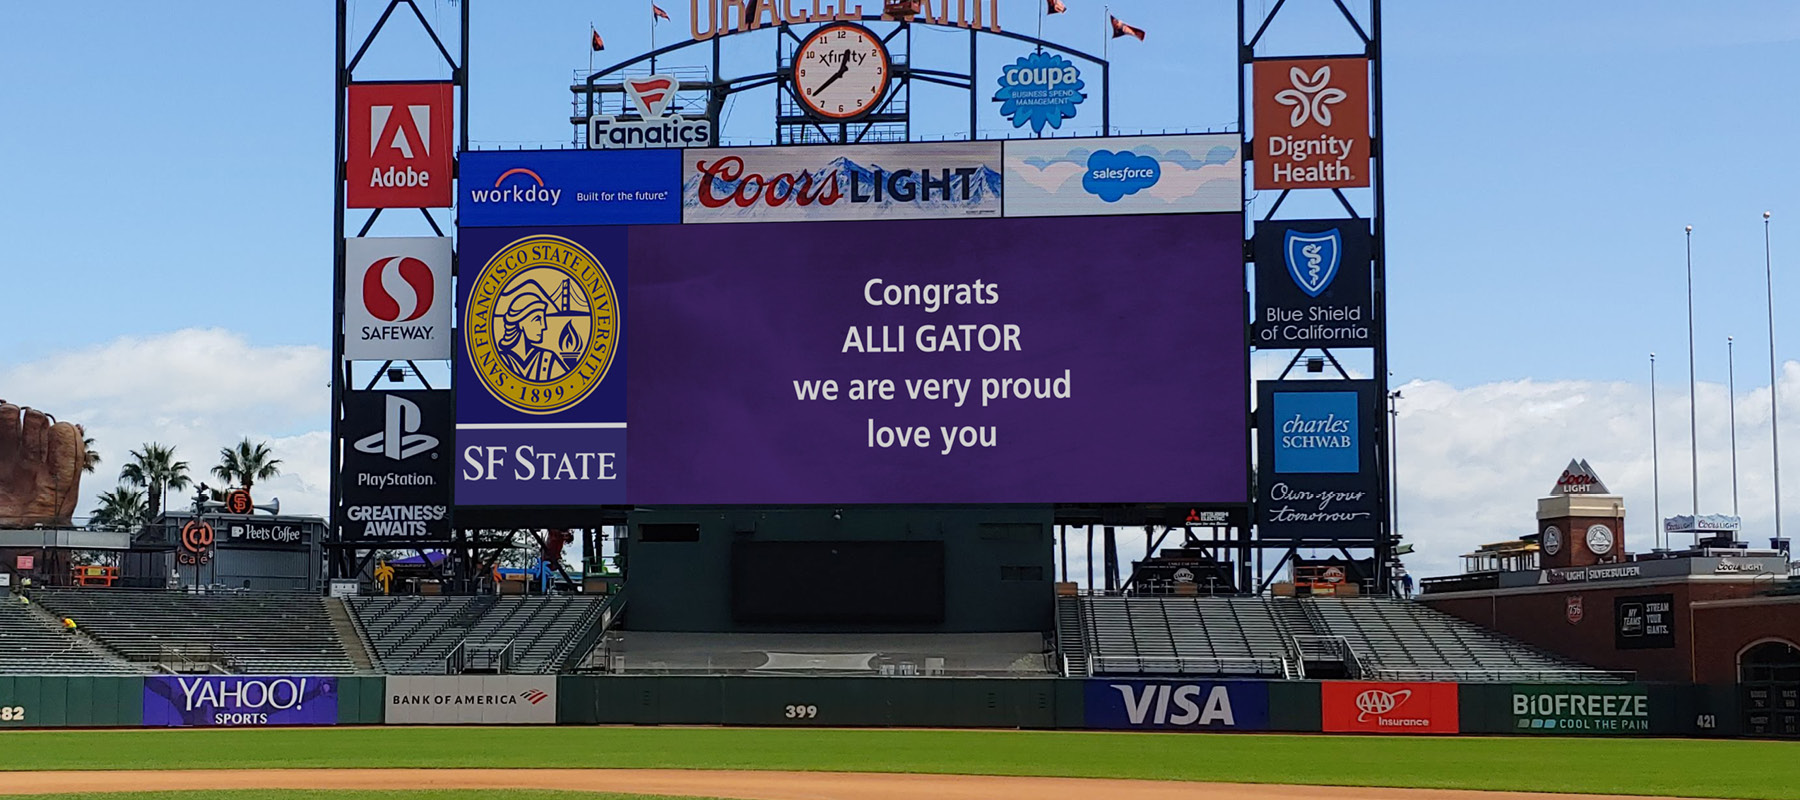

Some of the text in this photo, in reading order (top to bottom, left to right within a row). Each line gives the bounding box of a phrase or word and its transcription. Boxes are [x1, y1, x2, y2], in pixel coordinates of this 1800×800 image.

[820, 36, 828, 44] 11
[837, 31, 846, 39] 12
[858, 35, 863, 43] 1
[806, 51, 815, 59] 10
[819, 49, 867, 67] xfinty
[872, 49, 877, 57] 2
[800, 69, 806, 77] 9
[877, 67, 882, 75] 3
[1006, 66, 1078, 90] coupa
[806, 88, 812, 96] 8
[870, 86, 876, 94] 4
[1012, 89, 1074, 99] BUSINESS SPEND
[820, 100, 825, 108] 7
[857, 99, 863, 107] 5
[1016, 97, 1068, 106] MANAGEMENT
[838, 105, 844, 113] 6
[595, 119, 709, 145] Fanatics
[1269, 134, 1354, 162] Dignity
[370, 166, 429, 187] Adobe
[1093, 167, 1154, 181] salesforce
[697, 155, 979, 208] Coors LIGHT
[471, 184, 561, 205] workday
[577, 192, 599, 201] Built
[601, 192, 615, 201] for
[617, 192, 633, 201] the
[864, 278, 999, 313] Congrats
[473, 245, 612, 387] SAN FRANCISCO STATE UNIVERSITY
[1267, 306, 1360, 321] Blue Shield
[361, 326, 434, 340] SAFEWAY
[842, 323, 1022, 353] ALLI GATOR
[1261, 324, 1368, 340] of California
[520, 385, 565, 404] 1899
[793, 369, 1071, 407] we are very proud
[1282, 413, 1350, 433] charles
[868, 418, 997, 456] love you
[1282, 436, 1351, 448] SCHWAB
[463, 445, 507, 481] SF
[358, 472, 435, 489] PlayStation
[1557, 470, 1599, 485] Coors
[1563, 484, 1591, 493] LIGHT
[1270, 482, 1366, 511] Own your
[347, 505, 447, 521] GREATNESS
[1269, 505, 1371, 522] tomorrow
[271, 525, 300, 543] Coffee
[363, 521, 427, 536] AWAITS
[179, 551, 208, 565] Caé
[1567, 571, 1585, 581] LIGHT
[1646, 603, 1669, 613] STREAM
[1623, 617, 1641, 625] TEAMS
[177, 677, 306, 711] YAHOO!
[393, 695, 517, 705] BANK OF AMERICA
[1110, 684, 1235, 726] VISA
[1360, 690, 1391, 713] AAA
[0, 706, 25, 721] 82
[785, 705, 817, 718] 399
[215, 713, 268, 725] SPORTS
[1378, 716, 1429, 726] Insurance
[1559, 719, 1649, 730] COOL THE PAIN
[1697, 714, 1716, 728] 421
